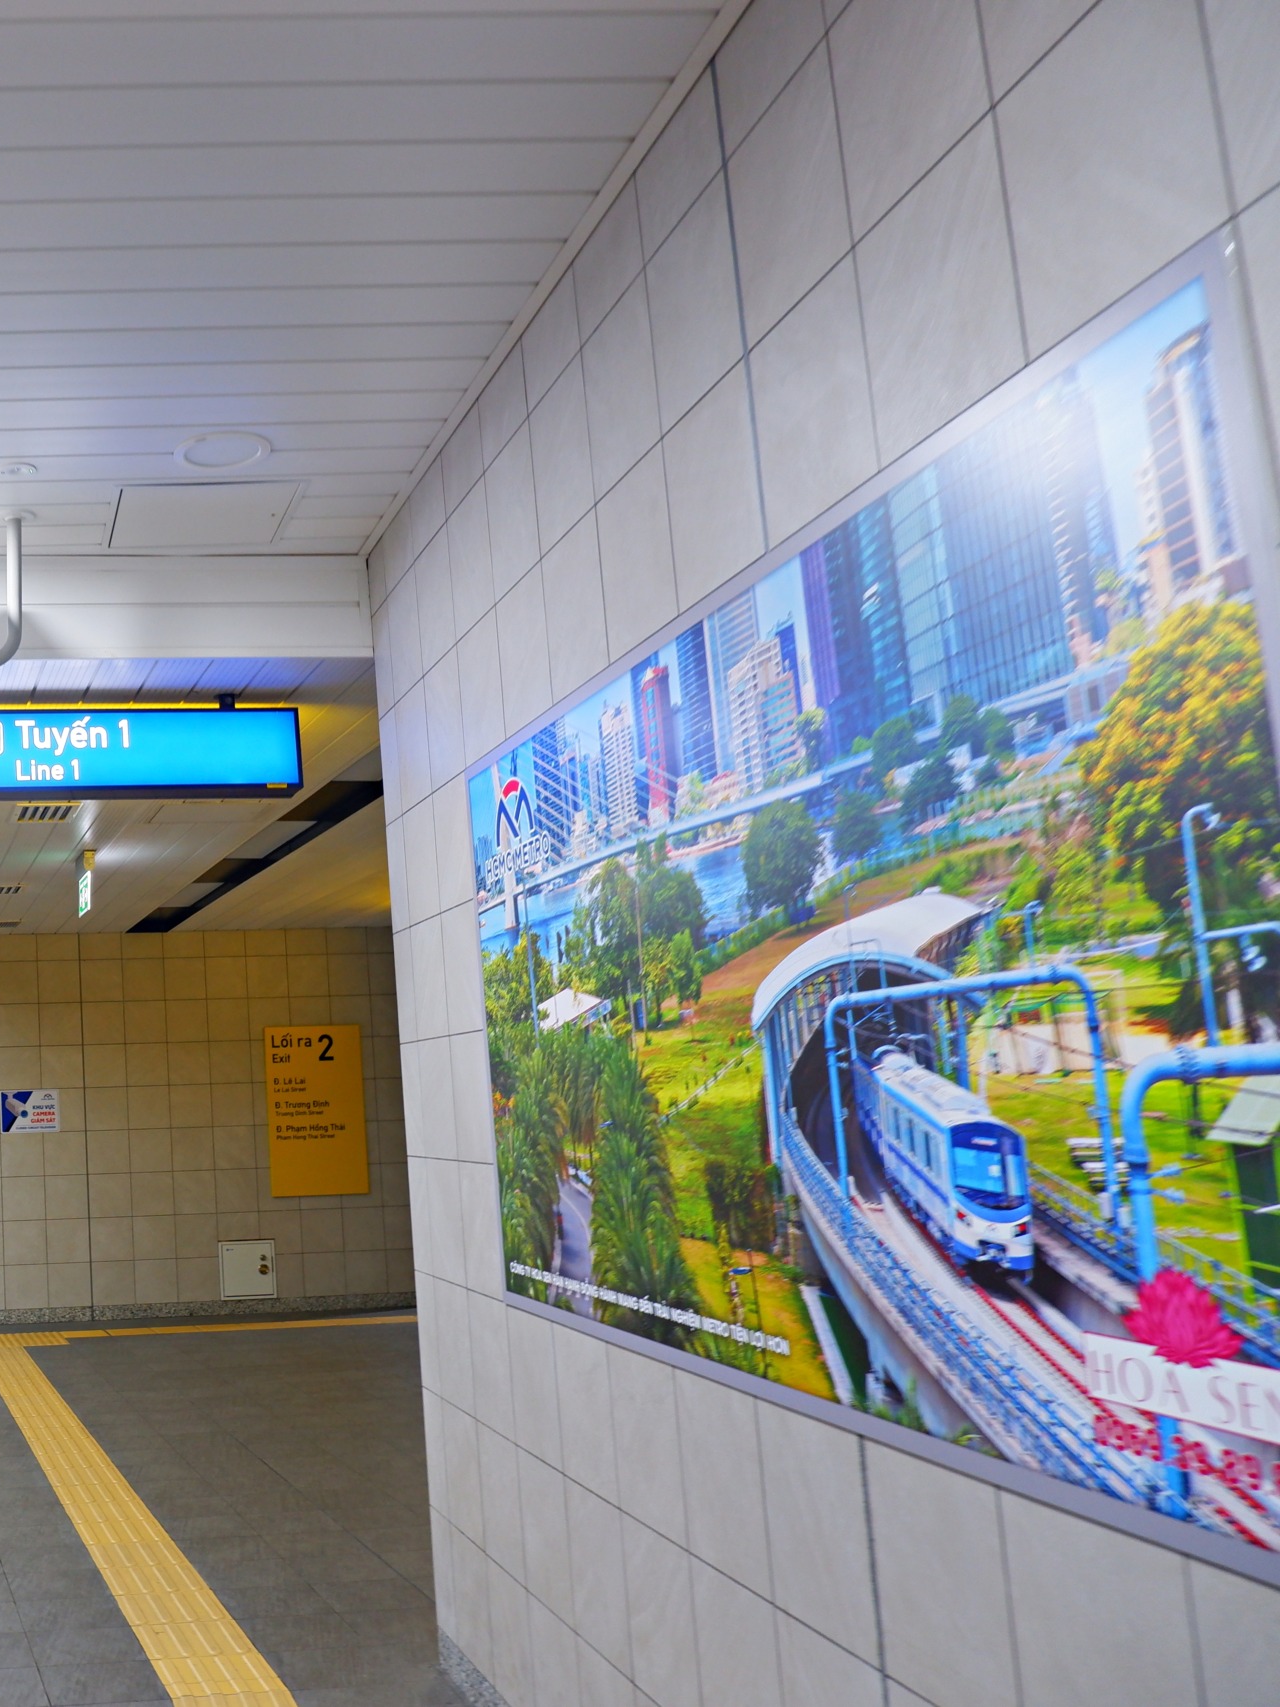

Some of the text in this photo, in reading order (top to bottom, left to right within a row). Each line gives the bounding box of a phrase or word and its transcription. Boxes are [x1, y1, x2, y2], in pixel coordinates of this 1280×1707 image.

[14, 716, 130, 756] Tuyến 1
[15, 759, 80, 781] Line 1
[485, 830, 551, 883] HCMC METRO
[271, 1033, 334, 1061] Lối ra 2
[272, 1053, 291, 1064] Exit
[294, 1077, 306, 1085] Lai
[1086, 1350, 1192, 1414] HOA
